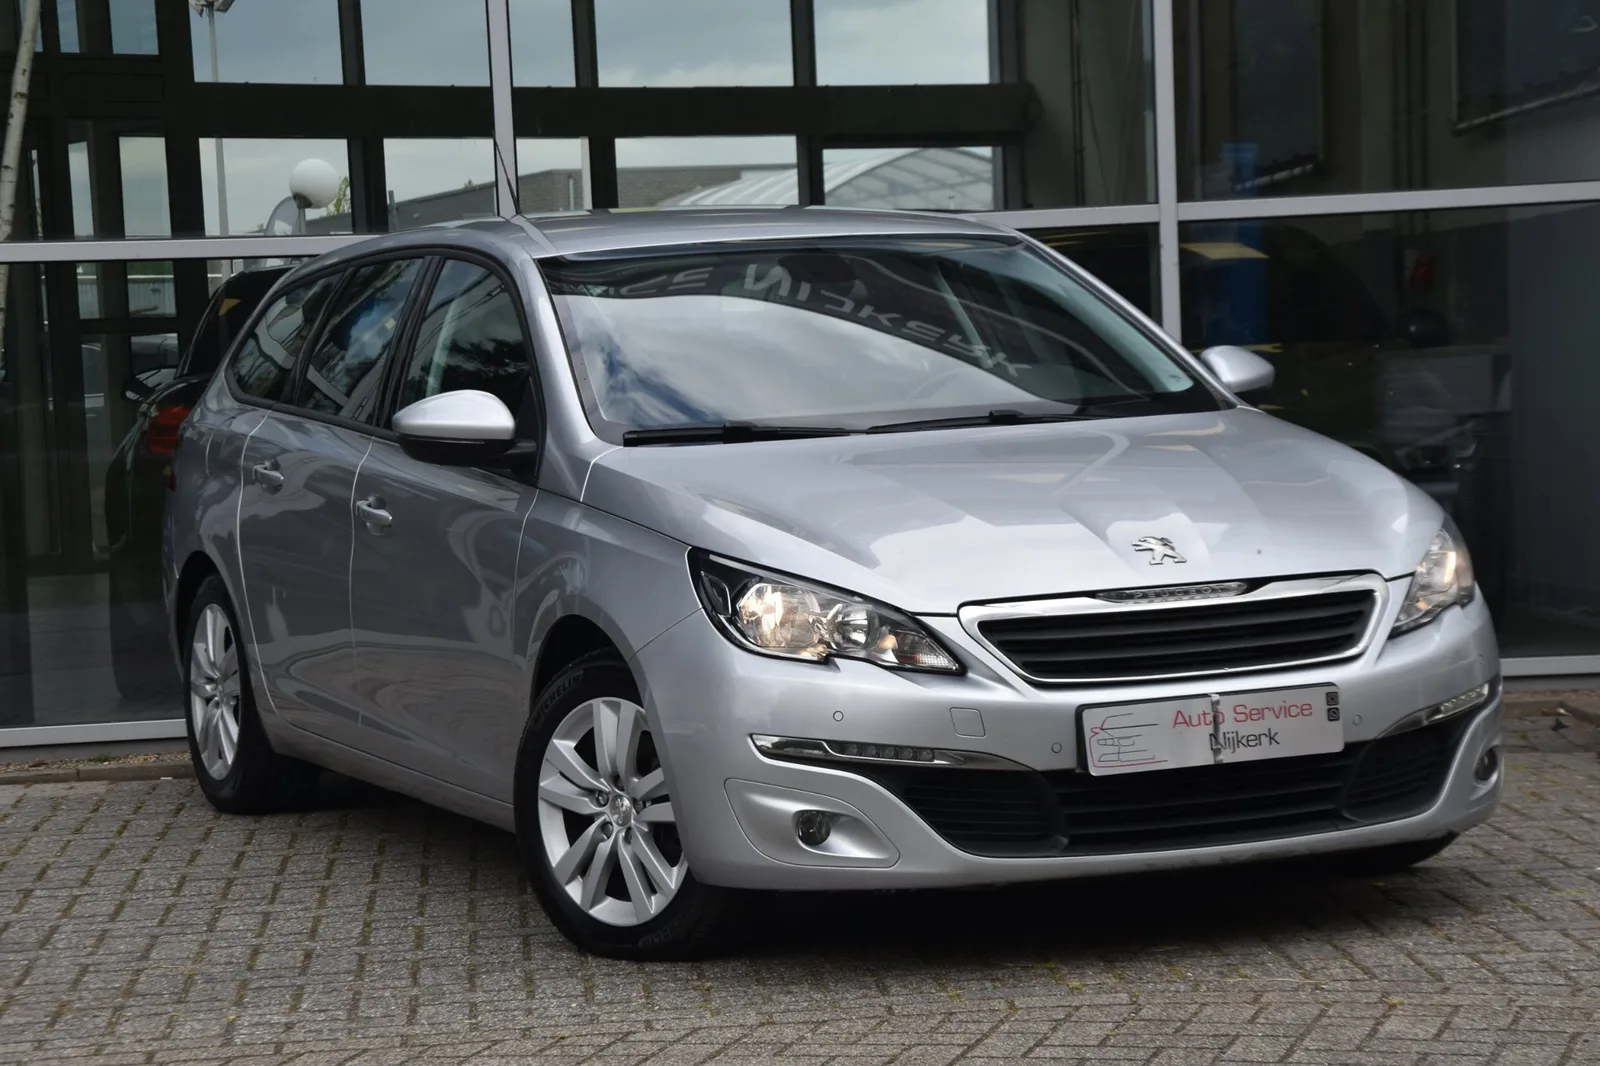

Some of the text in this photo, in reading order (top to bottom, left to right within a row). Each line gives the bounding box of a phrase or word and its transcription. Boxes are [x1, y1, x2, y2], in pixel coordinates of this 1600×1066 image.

[1134, 584, 1225, 600] PEUGEOT
[530, 668, 584, 731] MICHELIN
[1172, 700, 1313, 729] Auto Service
[1209, 728, 1280, 754] Nijkerk
